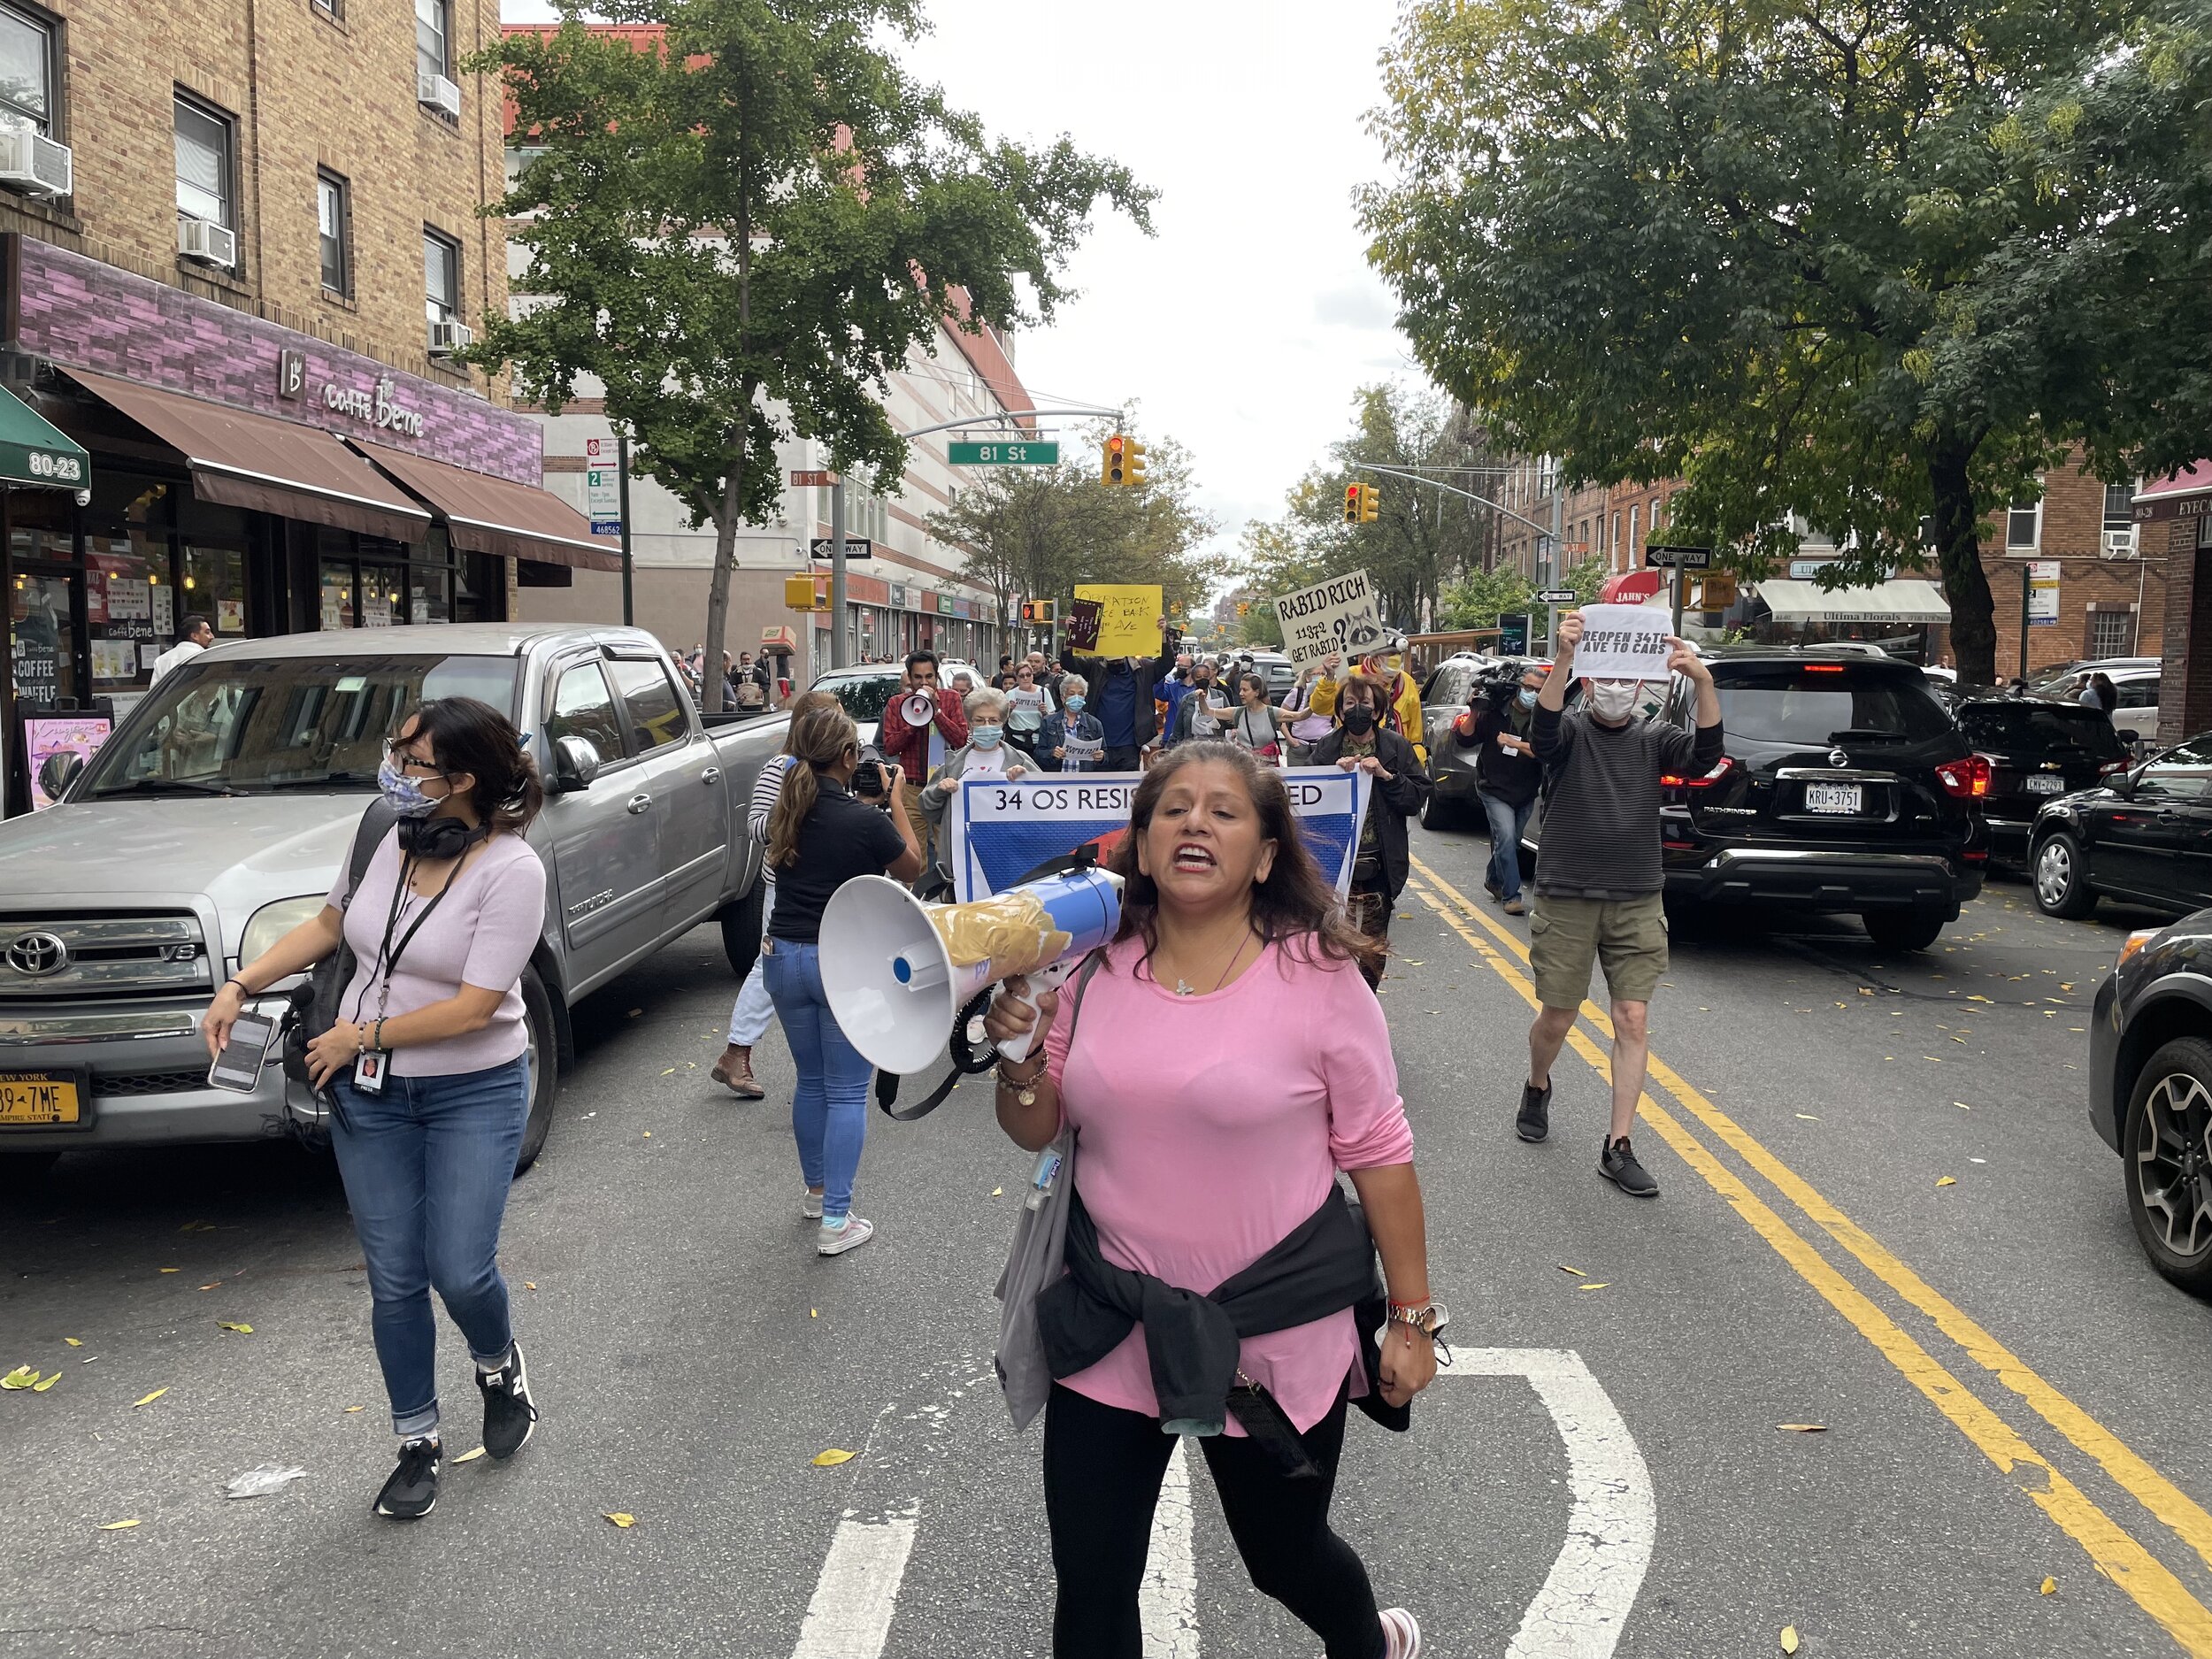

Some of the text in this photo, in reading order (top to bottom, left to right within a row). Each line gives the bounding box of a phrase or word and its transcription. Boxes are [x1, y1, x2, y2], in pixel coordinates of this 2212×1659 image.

[979, 446, 1026, 461] 81 St
[29, 452, 81, 480] 80-23
[591, 472, 598, 486] 2
[793, 473, 818, 485] 81 ST
[596, 526, 620, 534] 468562
[1655, 552, 1702, 563] ONE WAY
[1279, 575, 1366, 621] RABID RICH
[1616, 592, 1650, 603] JAHN'S
[1824, 611, 1901, 620] Ultima Florals
[1295, 621, 1326, 640] 11372
[1582, 631, 1632, 642] REOPEN
[1292, 637, 1339, 663] GET RABID
[1583, 641, 1666, 654] AVE TO CARS
[19, 660, 54, 677] COFFEE
[995, 789, 1022, 810] 34
[1032, 789, 1068, 810] OS
[1703, 806, 1757, 816] PATHFINDER
[159, 944, 196, 961] V8
